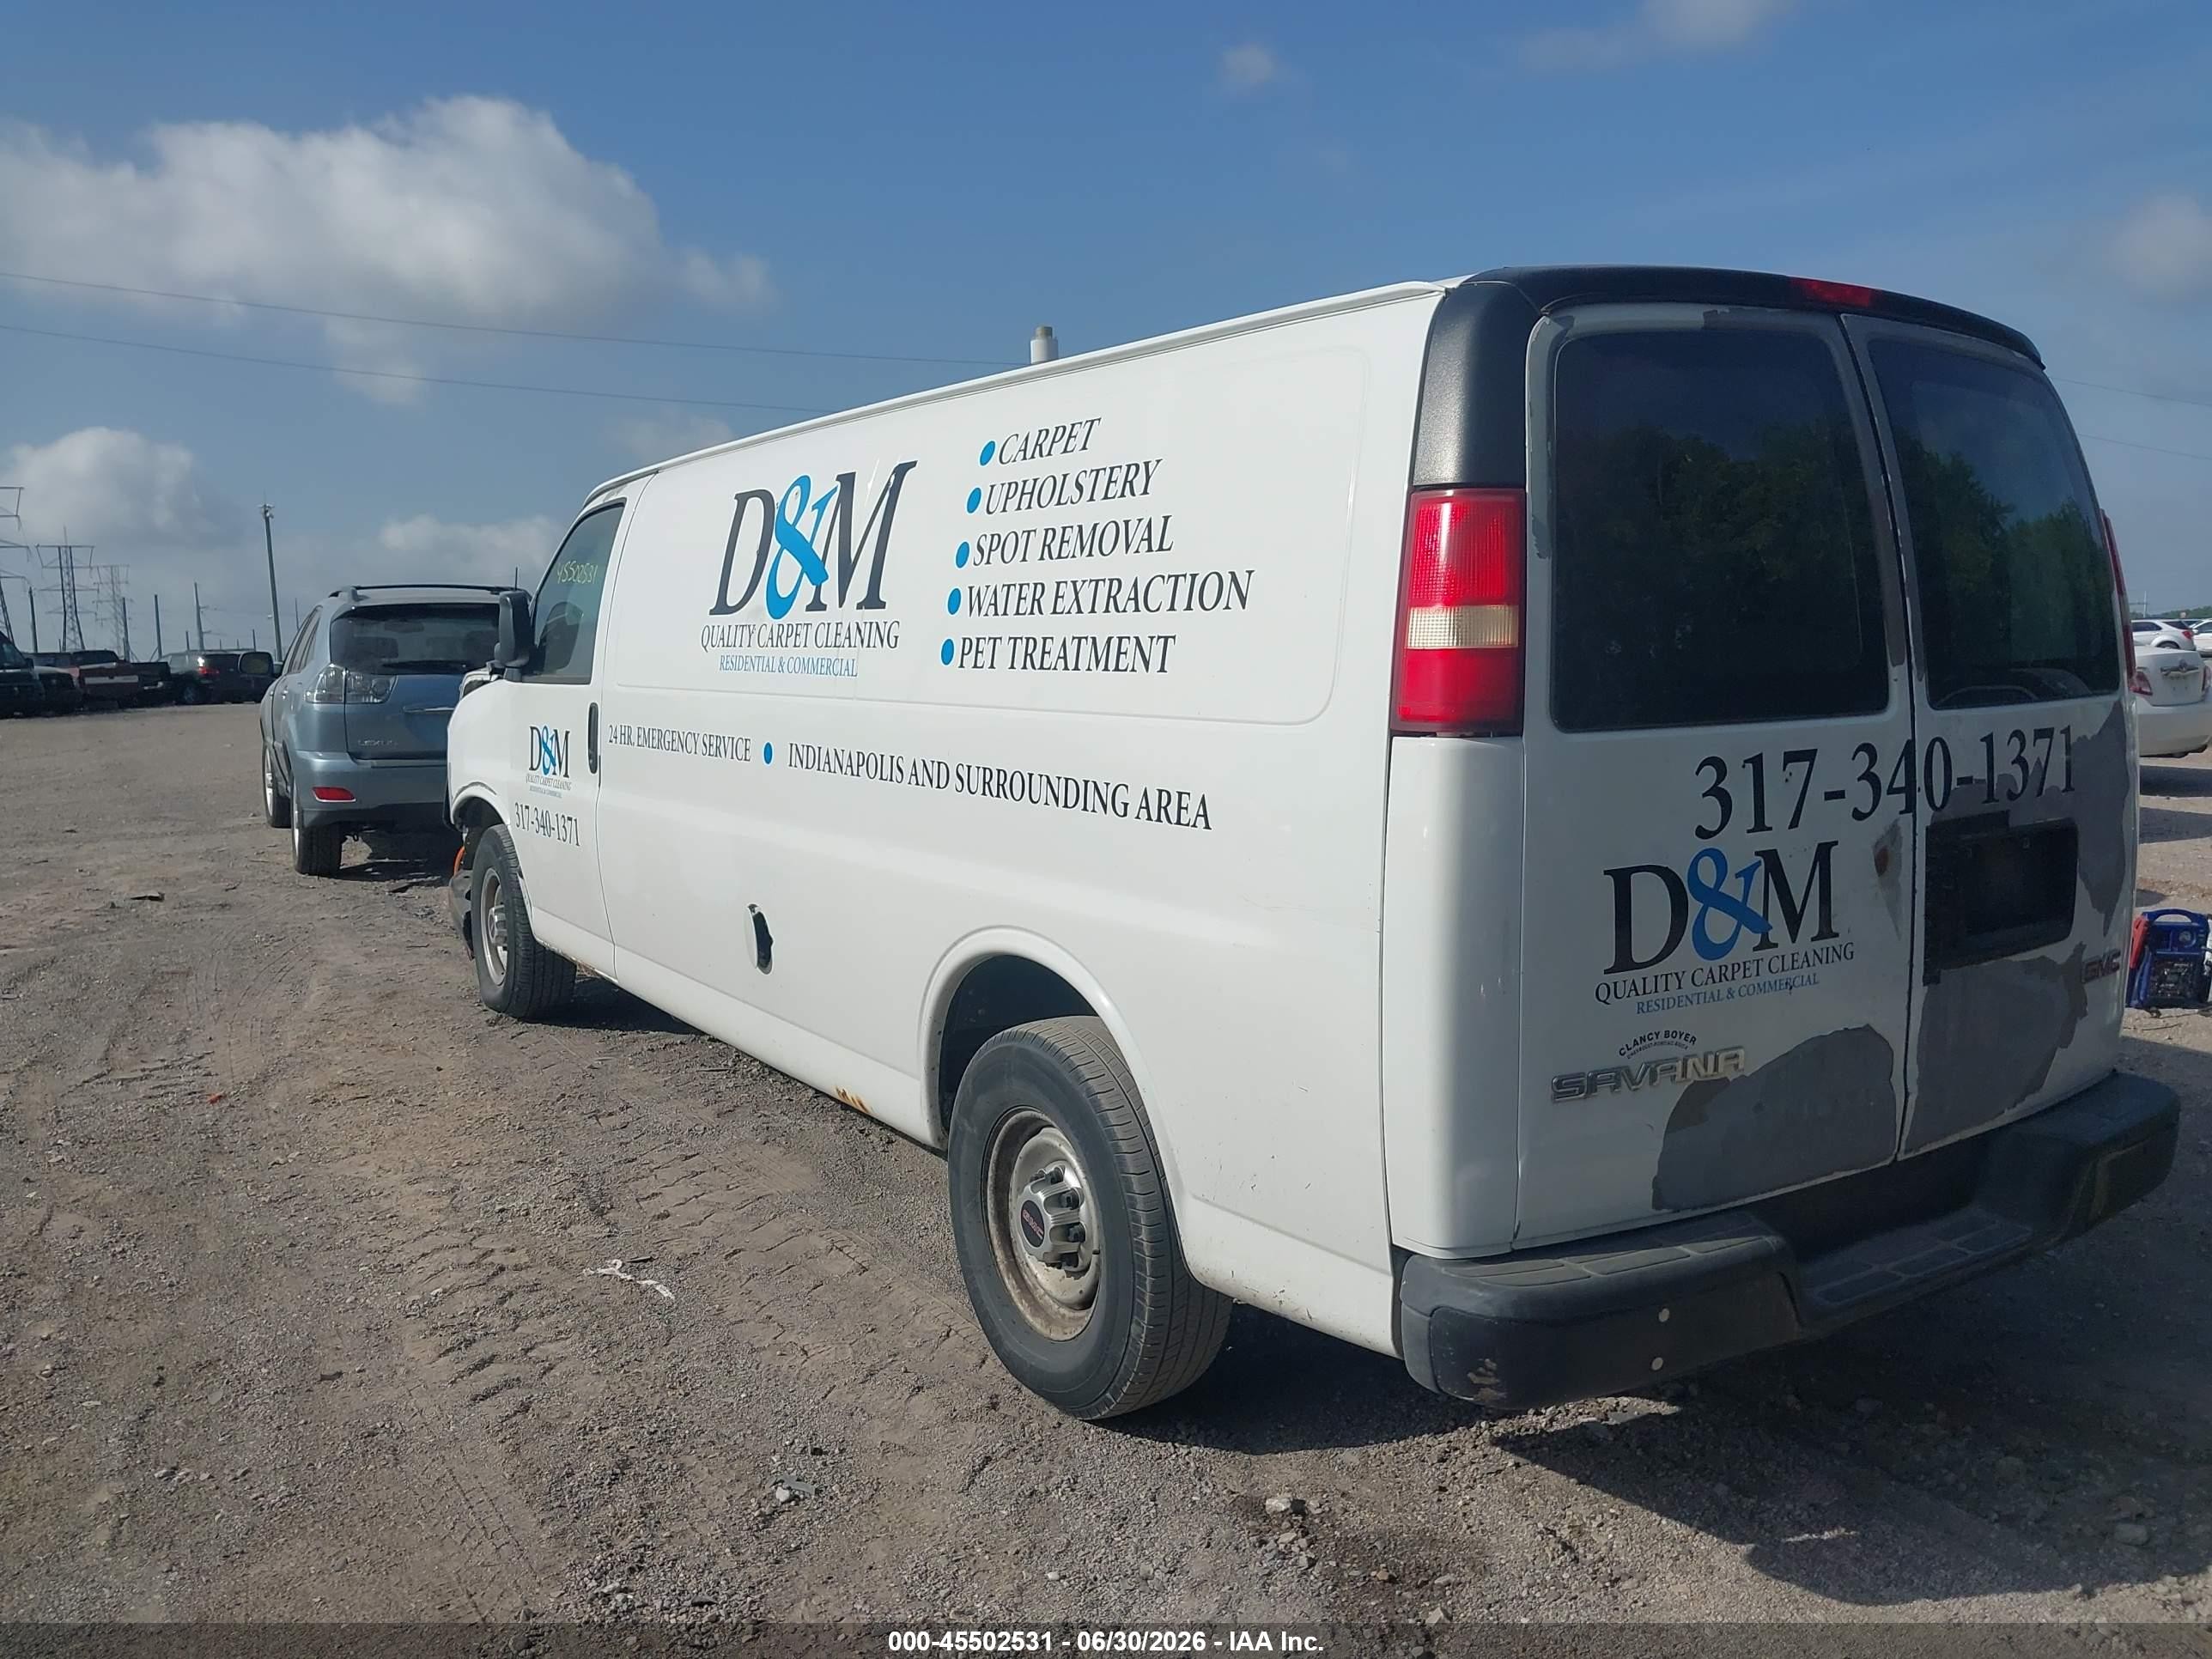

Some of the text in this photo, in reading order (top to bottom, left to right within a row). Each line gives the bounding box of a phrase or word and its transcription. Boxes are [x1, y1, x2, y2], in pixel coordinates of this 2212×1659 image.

[999, 417, 1102, 465] CARPET
[986, 459, 1163, 514] UPHOLSTERY
[708, 460, 917, 620] D&M
[972, 514, 1174, 567] SPOT REMOVAL
[968, 569, 1255, 617] WATER EXTRACTION
[701, 620, 900, 653] QUALITY CARPET CLEANING
[957, 635, 1176, 673] PET TREATMENT
[720, 654, 858, 678] RESIDENTIAL & COMMERCIAL
[529, 726, 570, 778] D&M
[609, 724, 618, 744] 24
[636, 726, 700, 755] EMERGENCY
[702, 732, 751, 762] SERVICE
[788, 742, 1212, 830] INDIANAPOLIS AND SURROUNDING AREA
[1693, 725, 2075, 840] 317-340-1371
[515, 802, 580, 847] 317-340-1371
[1603, 840, 1839, 975] D&M
[1595, 942, 1855, 1006] QUALITY CARPET CLEANING
[1637, 973, 1820, 1015] RESIDENTIAL & COMMERCIAL
[1619, 1030, 1660, 1056] CLANCY
[1664, 1030, 1697, 1045] BOYER
[1552, 1046, 1746, 1103] SAVANA
[1022, 1209, 1044, 1240] GMC
